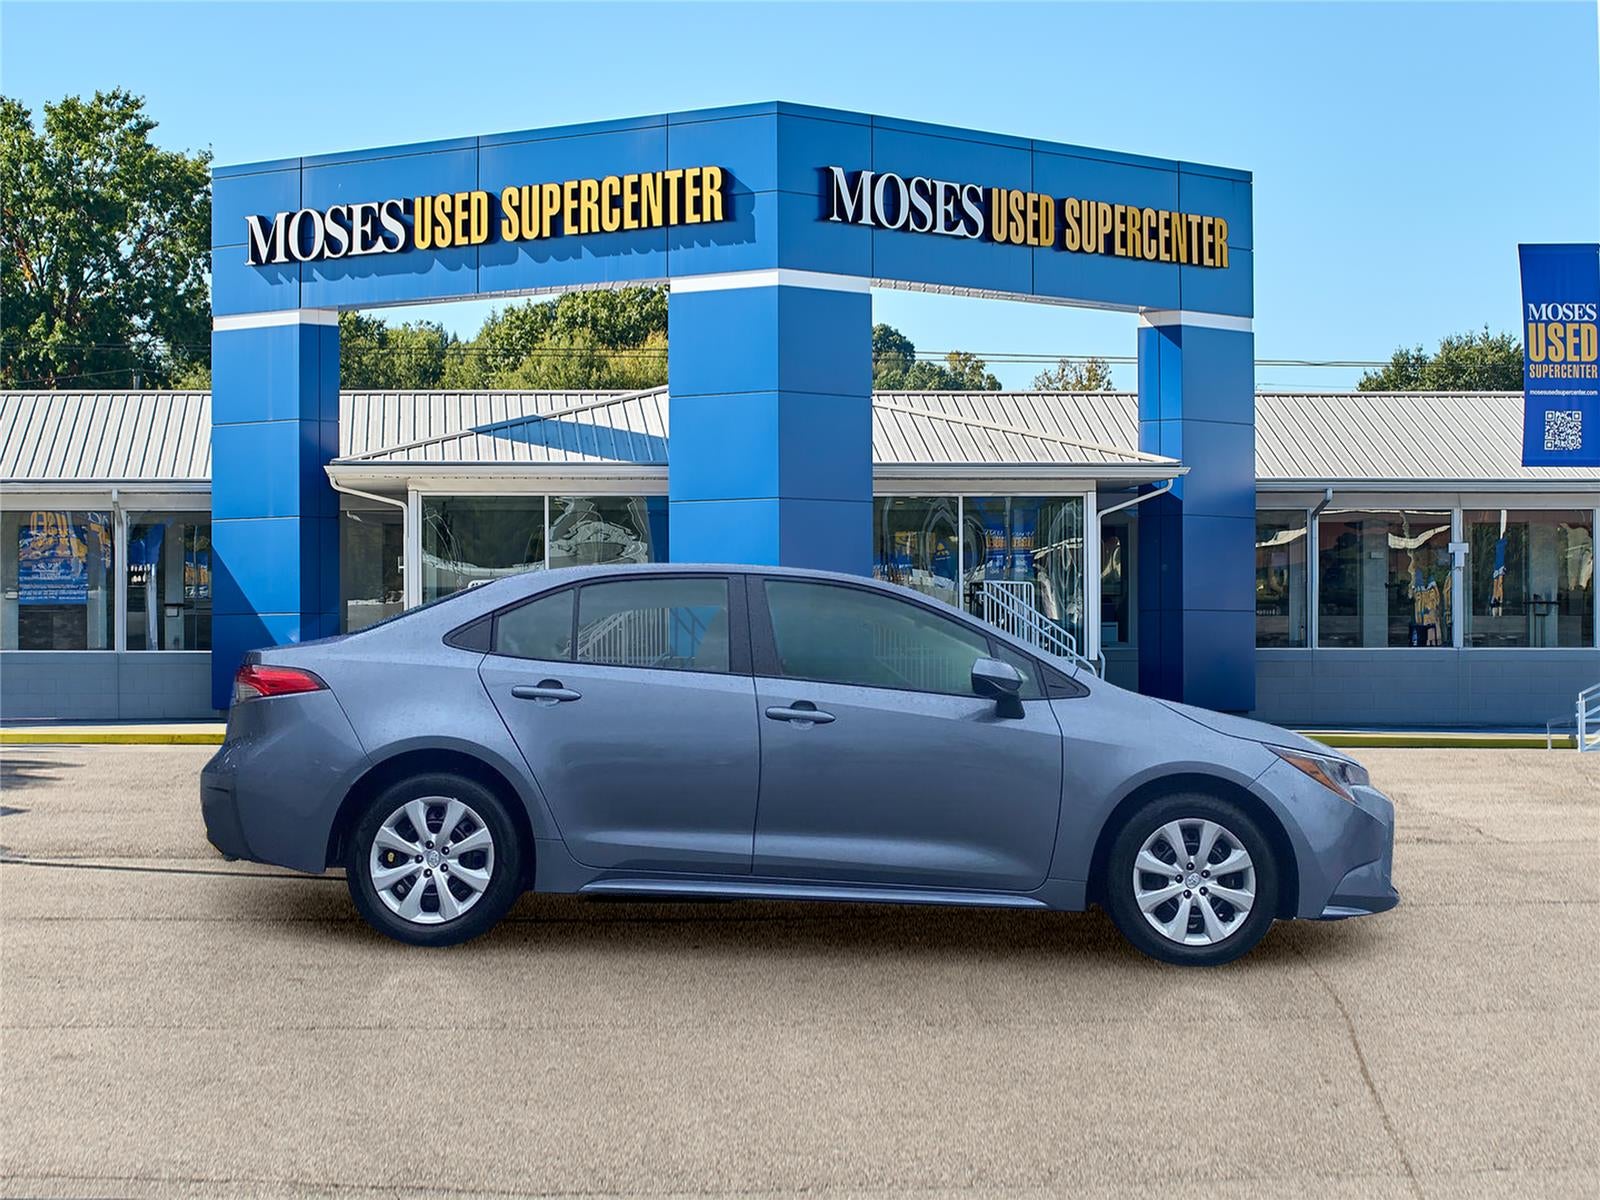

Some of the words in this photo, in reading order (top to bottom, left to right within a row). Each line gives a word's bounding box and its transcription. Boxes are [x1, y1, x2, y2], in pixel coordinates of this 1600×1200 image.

[245, 199, 410, 267] MOSES
[413, 190, 490, 251] USED
[500, 166, 724, 242] SUPERCENTER
[829, 166, 986, 240] MOSES
[990, 187, 1056, 248] USED
[1065, 197, 1230, 269] SUPERCENTER
[1527, 303, 1598, 322] MOSES
[1528, 323, 1598, 363] USED
[1529, 364, 1598, 379] SUPERCENTER
